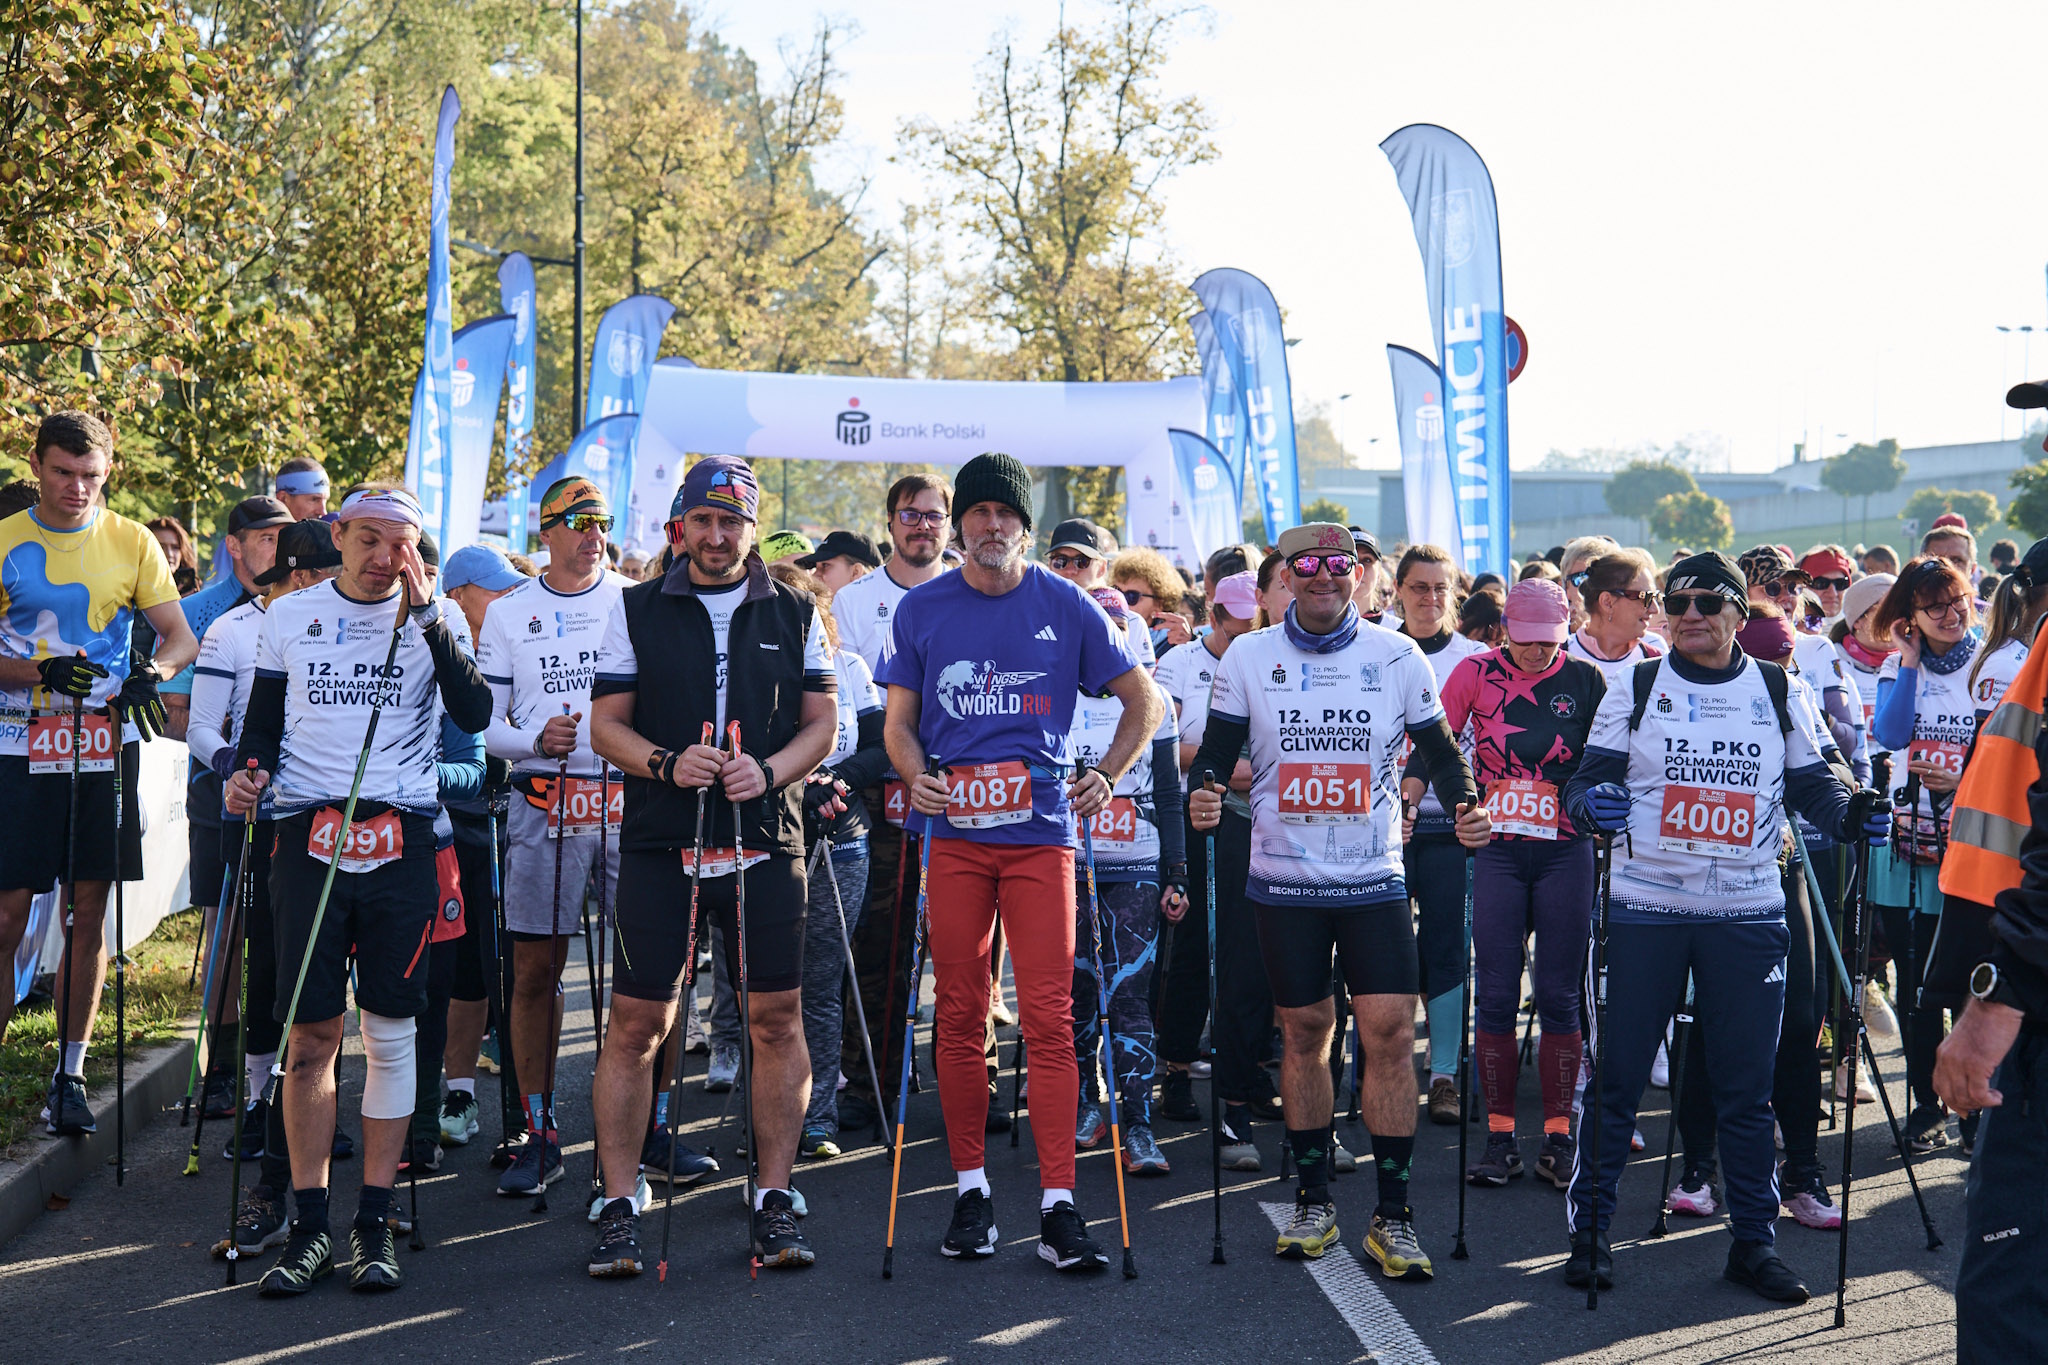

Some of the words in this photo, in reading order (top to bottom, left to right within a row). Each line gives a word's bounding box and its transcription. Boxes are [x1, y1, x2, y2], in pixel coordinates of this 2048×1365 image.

[881, 422, 928, 438] Bank
[933, 423, 985, 440] Polski
[307, 662, 339, 676] 12.
[353, 663, 405, 678] PKO
[539, 655, 567, 669] 12.
[307, 677, 403, 691] PÓŁMARATON
[974, 673, 1018, 685] WINGS
[308, 690, 401, 707] GLIWICKI
[979, 684, 1004, 695] LIFE
[957, 693, 1021, 715] WORLD
[1022, 693, 1051, 716] RUN
[1278, 709, 1309, 723] 12.
[1323, 709, 1371, 723] PKO
[1937, 715, 1974, 725] PKO
[1279, 725, 1371, 737] PÓŁMARATON
[33, 728, 111, 754] 4090
[1280, 737, 1370, 752] GLIWICKI
[1664, 737, 1698, 753] 12.
[1712, 740, 1761, 758] PKO
[1664, 754, 1761, 772] PÓŁMARATON
[1665, 766, 1759, 787] GLIWICKI
[950, 776, 1026, 808] 4087
[1283, 777, 1361, 807] 4051
[551, 790, 624, 819] 4094
[1485, 792, 1555, 821] 4056
[1665, 800, 1750, 838] 4008
[313, 822, 394, 855] 4091
[833, 841, 860, 851] GLIWICE
[735, 836, 744, 870] LEKI
[1268, 885, 1301, 896] BIEGNIJ
[1303, 888, 1316, 896] PO
[1317, 888, 1349, 897] SWOJE
[1350, 883, 1387, 895] GLIWICE
[690, 886, 700, 929] FLASH
[686, 932, 696, 985] CARBON
